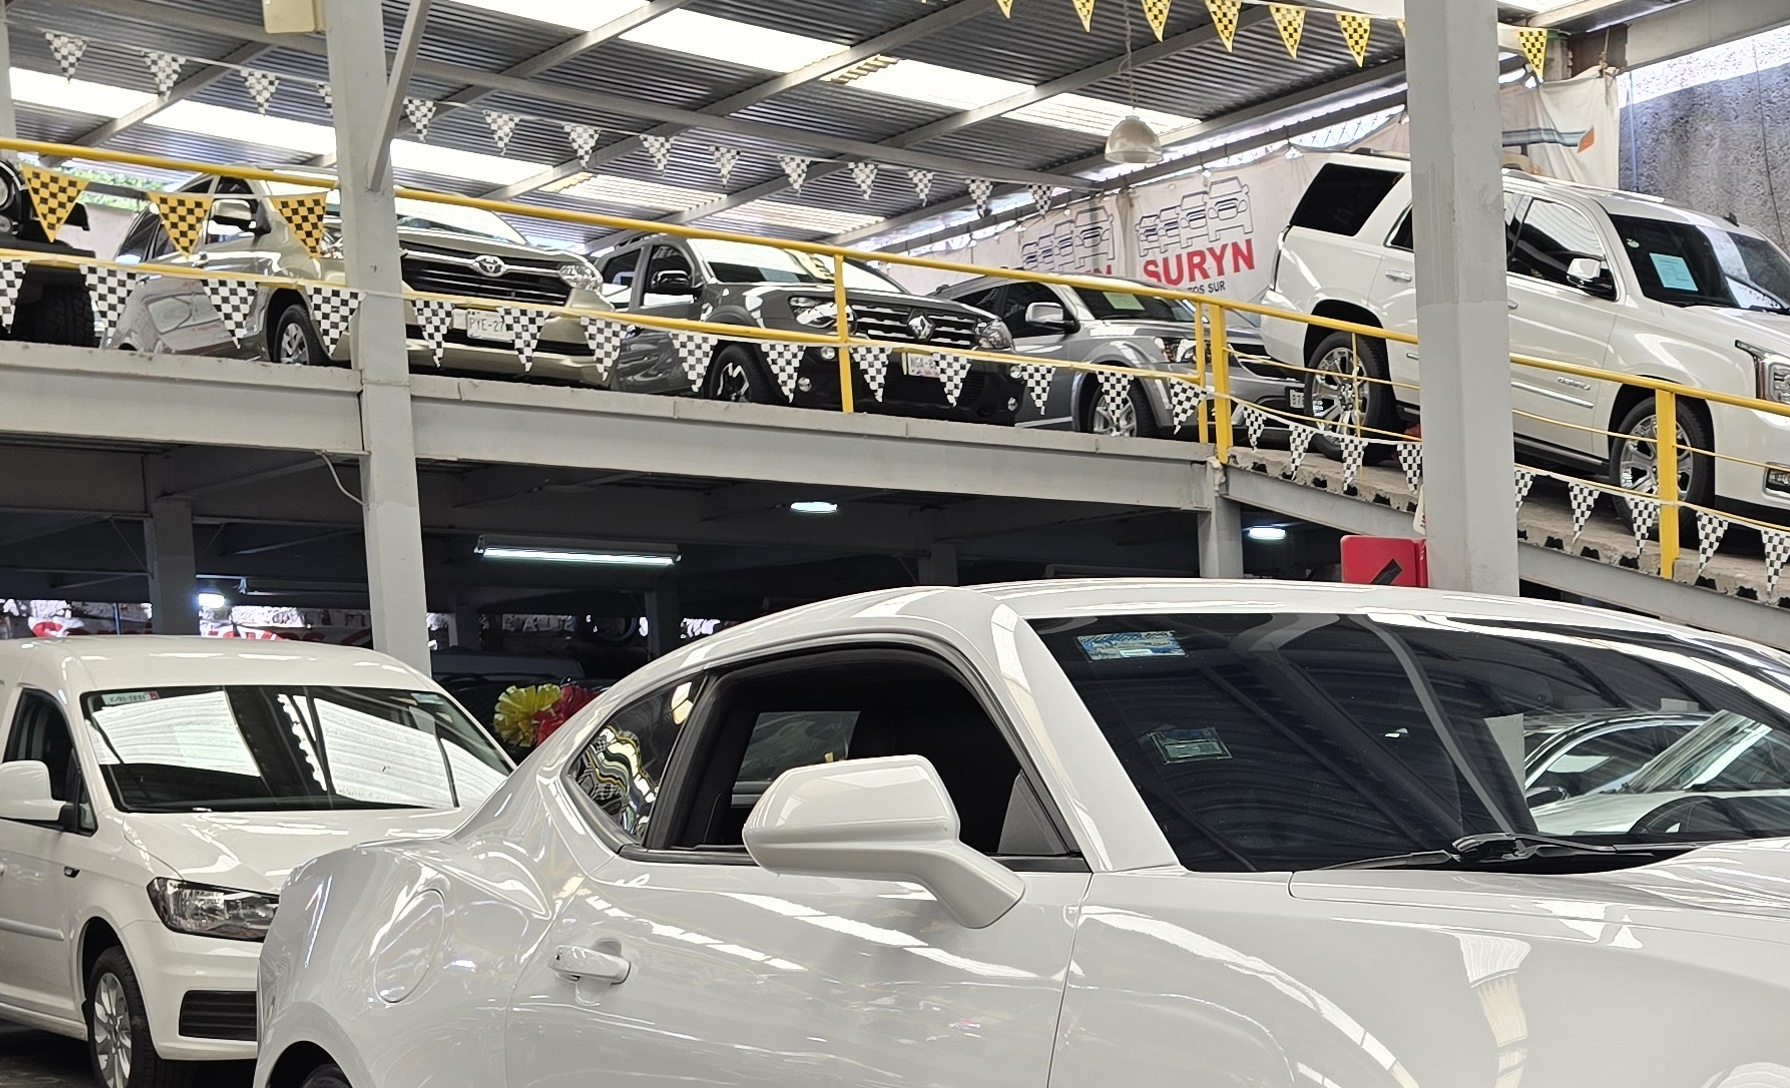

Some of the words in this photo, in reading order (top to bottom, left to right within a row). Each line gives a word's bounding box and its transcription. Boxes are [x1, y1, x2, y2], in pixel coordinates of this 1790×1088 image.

[1143, 238, 1256, 286] SURYN
[1207, 280, 1226, 294] SUR
[469, 317, 506, 333] PYE-27
